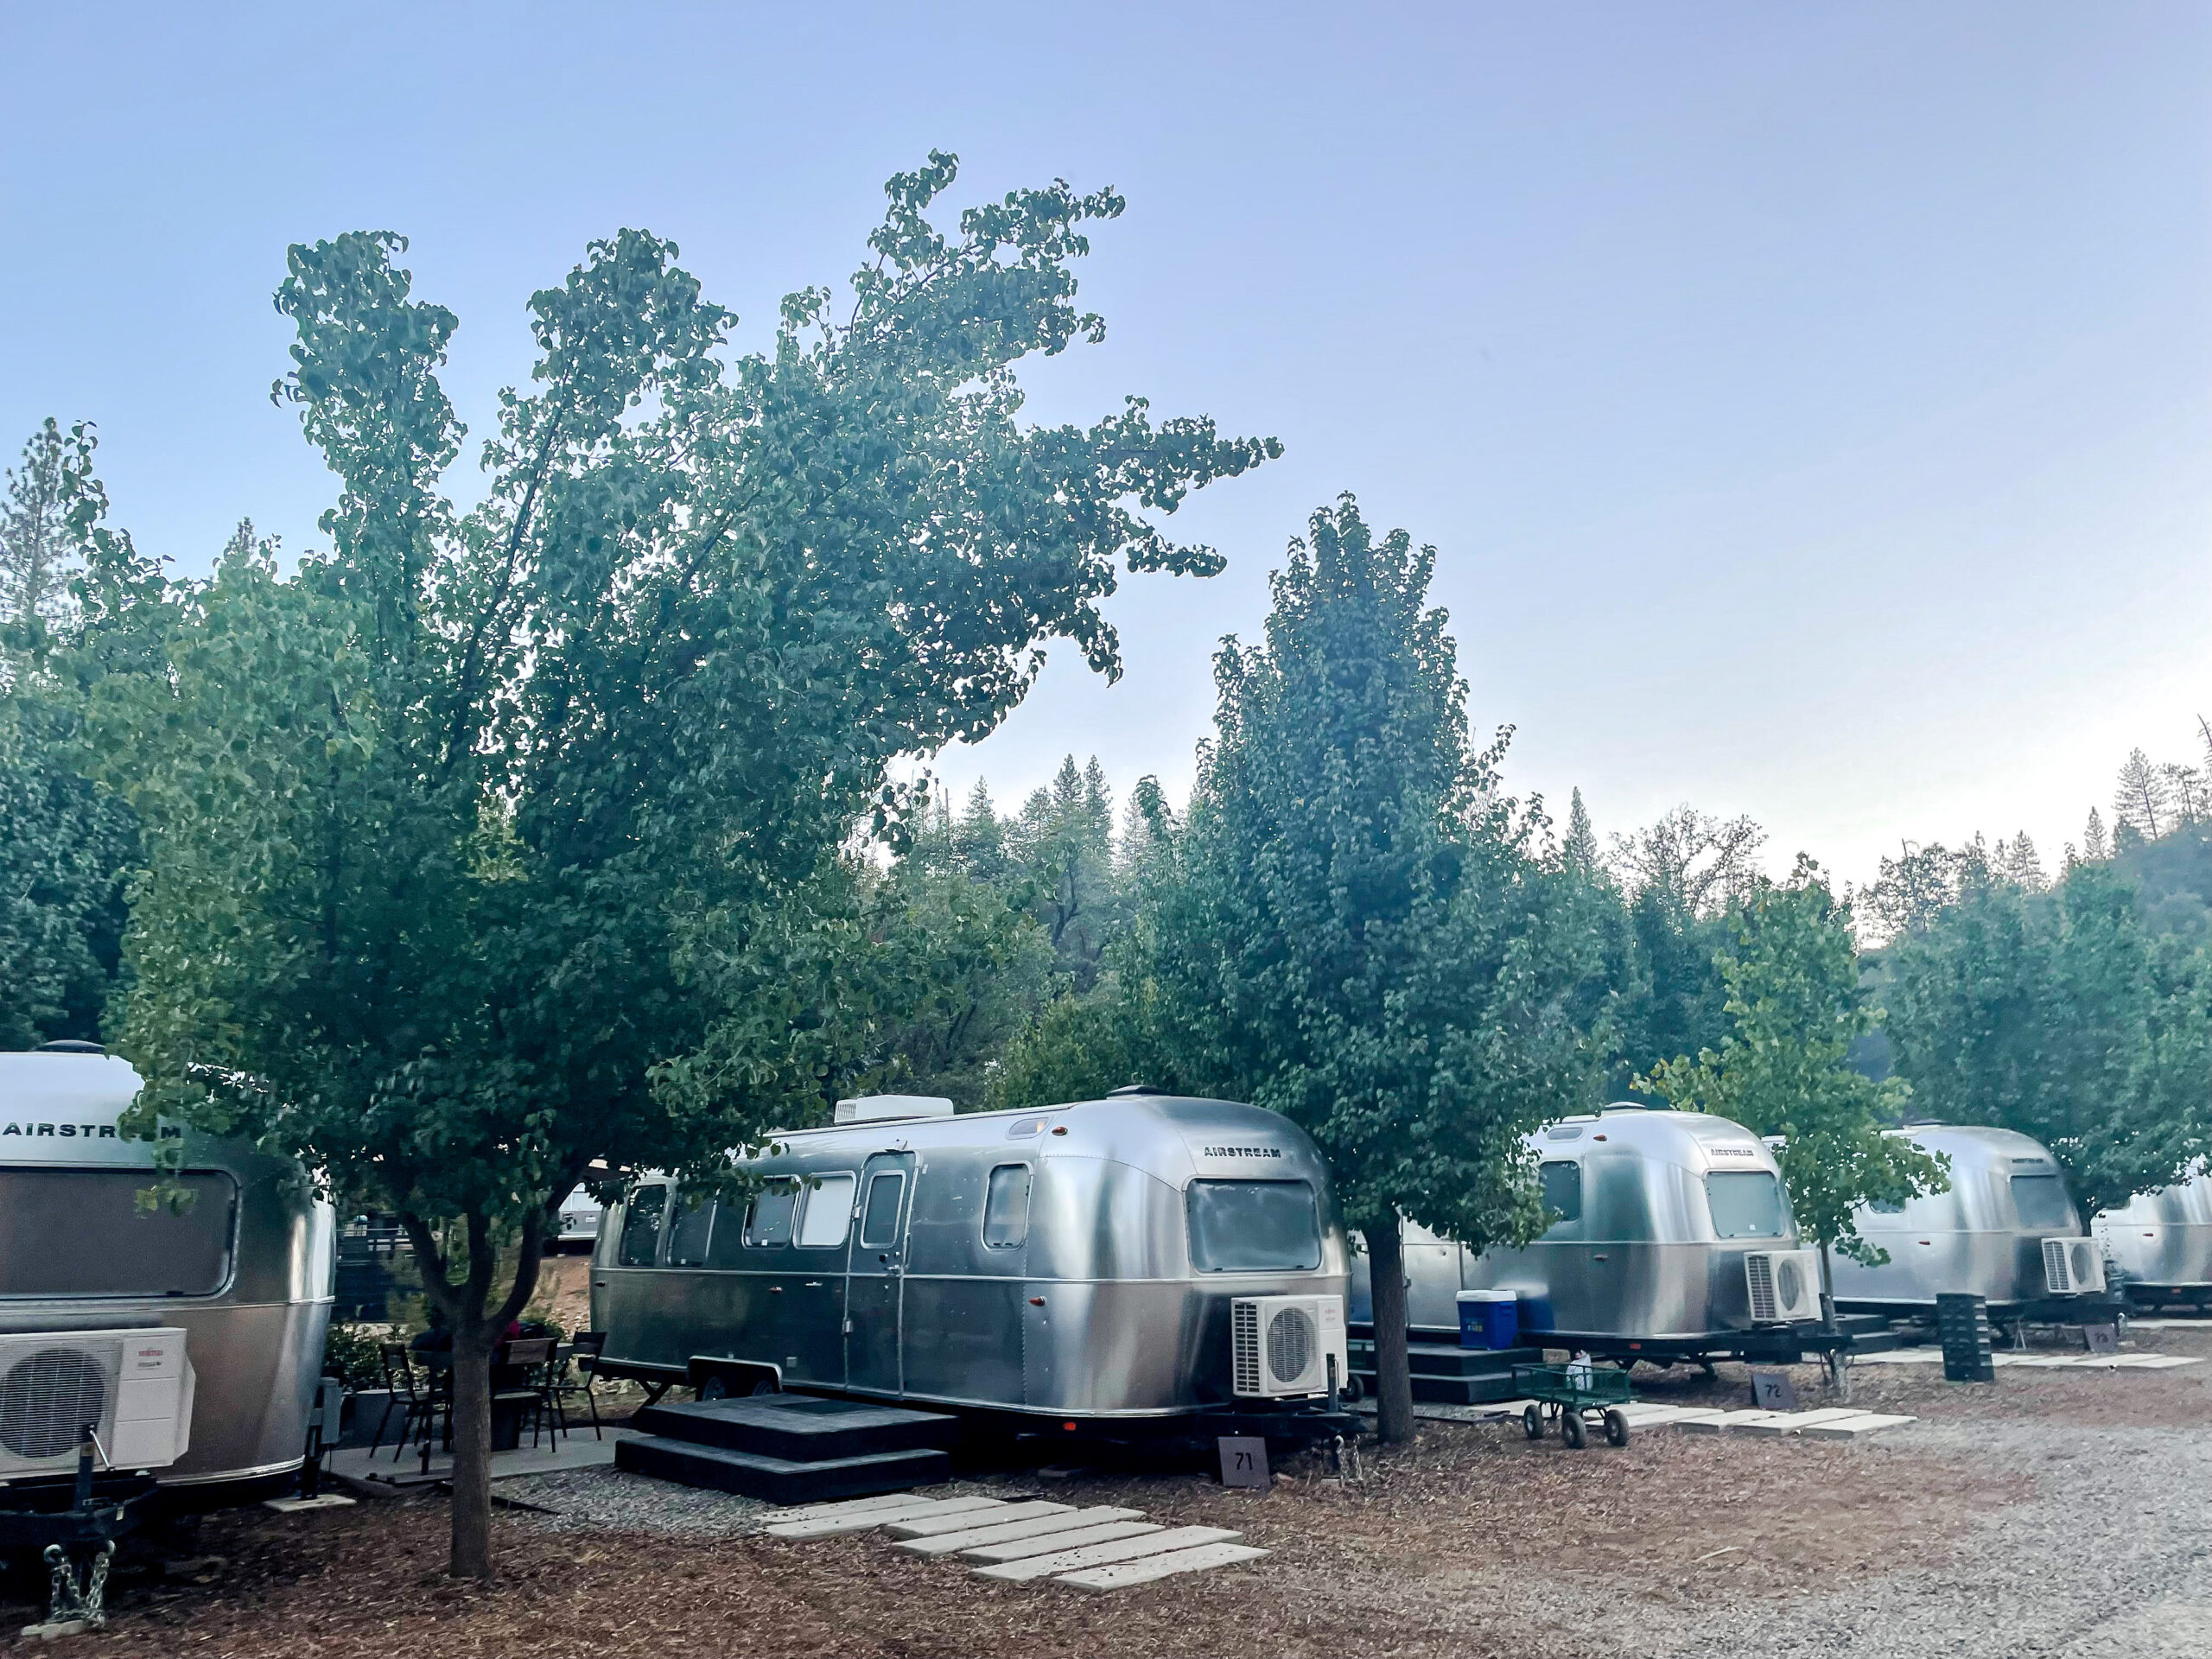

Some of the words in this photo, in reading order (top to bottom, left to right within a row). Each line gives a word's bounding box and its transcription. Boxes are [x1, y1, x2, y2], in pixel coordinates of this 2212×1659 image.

[3, 1122, 181, 1139] AIRSTRM
[1205, 1147, 1281, 1158] AIRSTREAM
[1764, 1383, 1782, 1398] 72
[1235, 1452, 1253, 1470] 71
